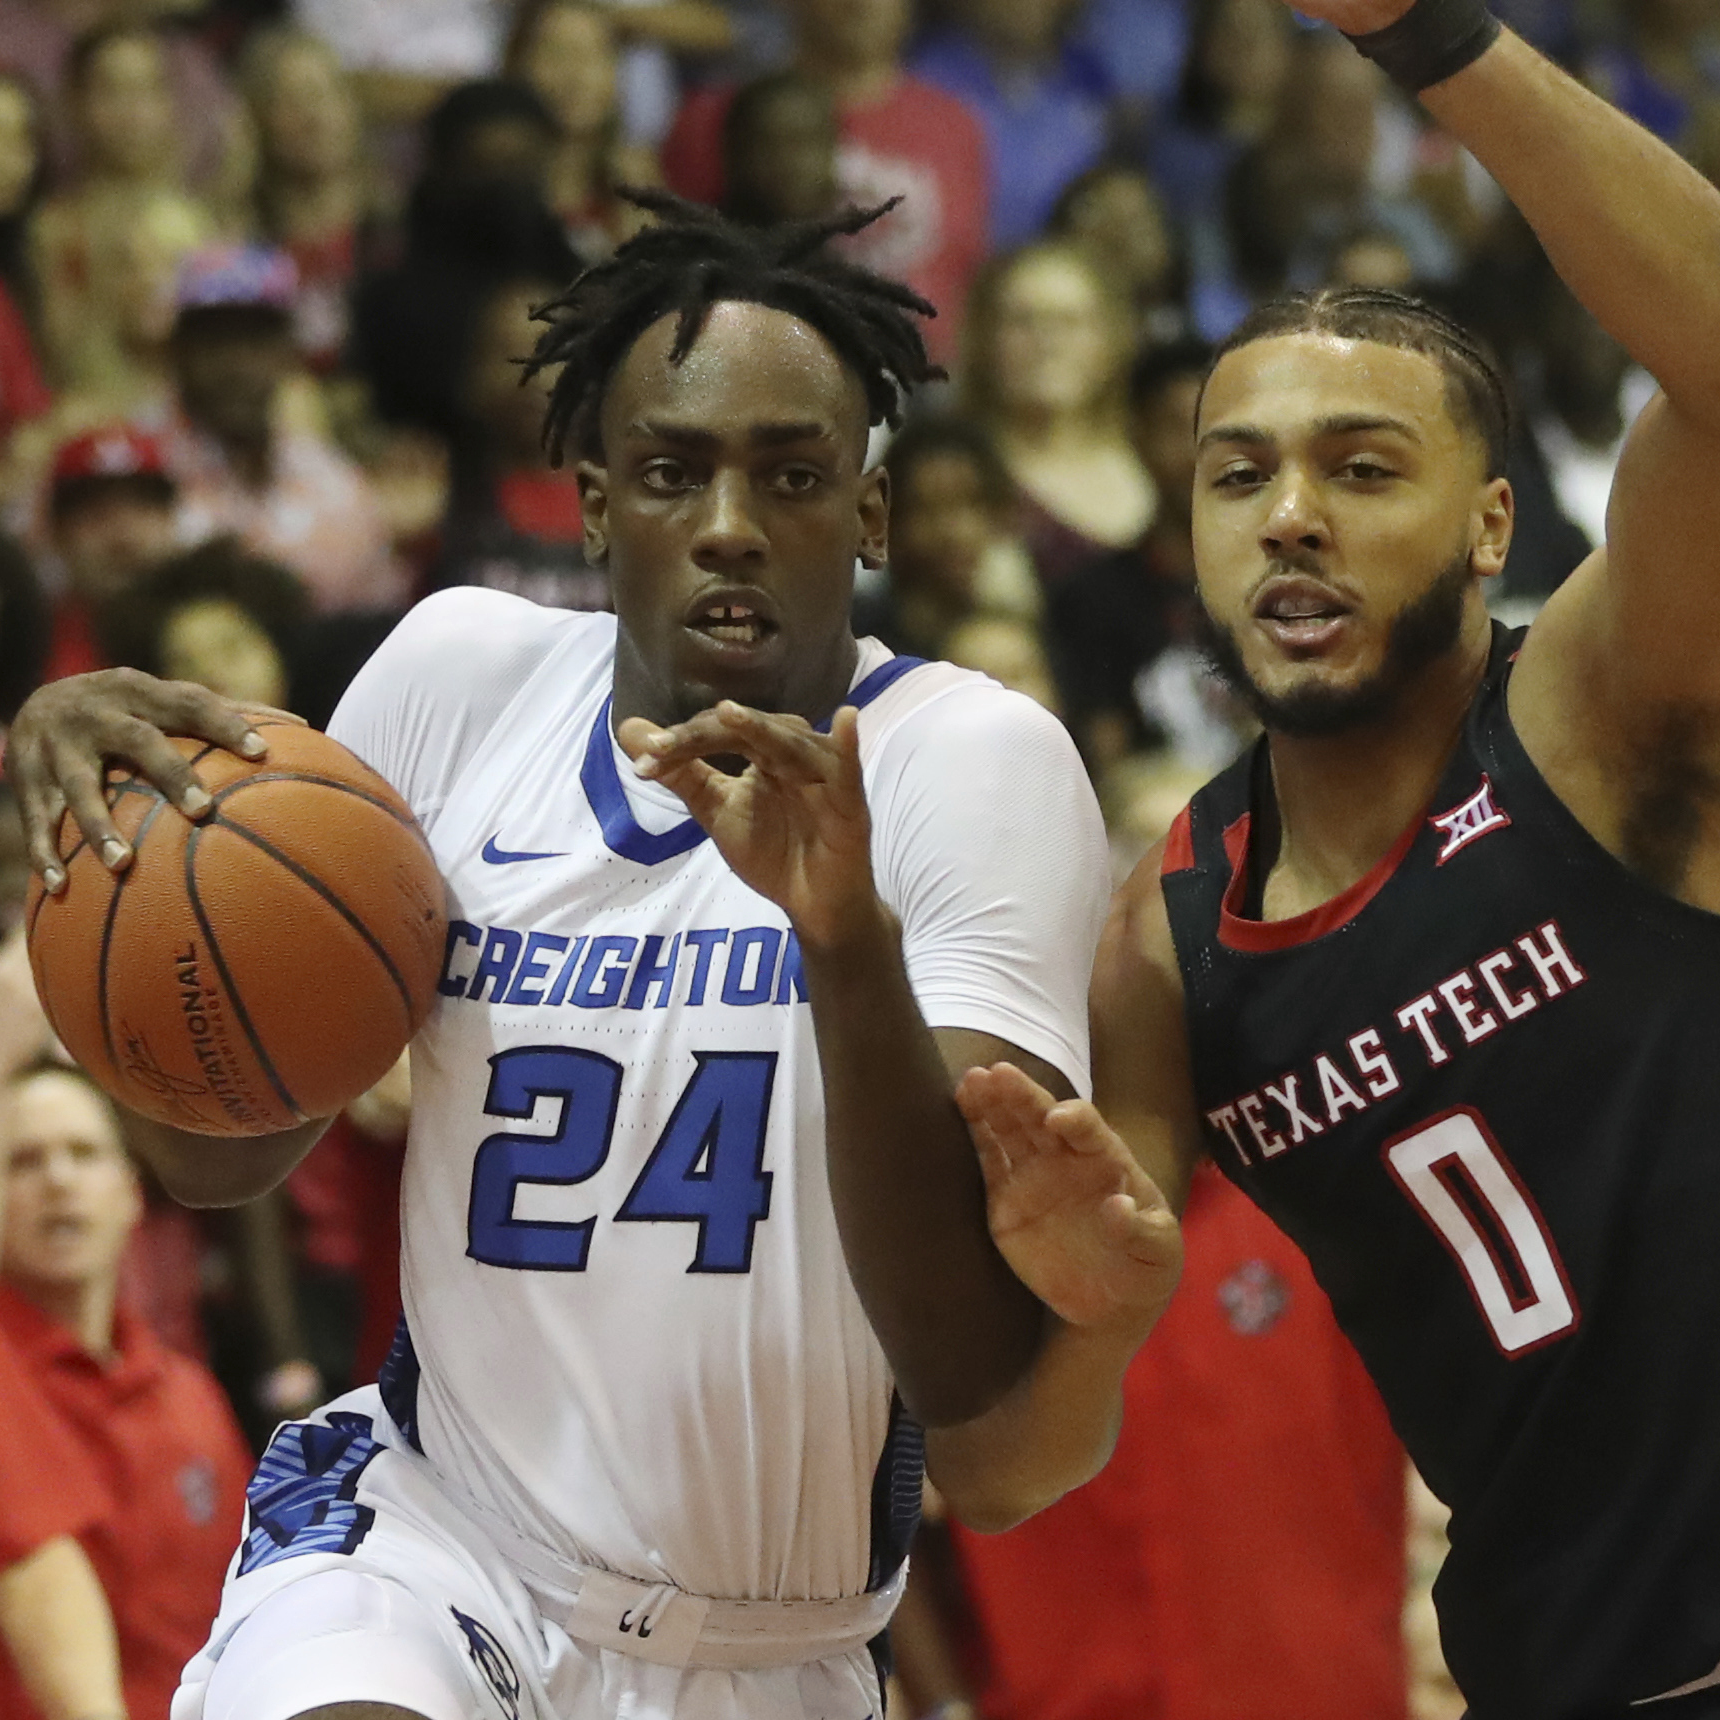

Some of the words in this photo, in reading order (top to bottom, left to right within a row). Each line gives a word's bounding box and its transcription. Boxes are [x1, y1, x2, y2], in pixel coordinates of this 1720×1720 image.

[465, 1044, 780, 1274] 24
[1207, 1027, 1403, 1168] TEXAS
[1394, 918, 1588, 1068] TECH
[1380, 1103, 1583, 1361] 0
